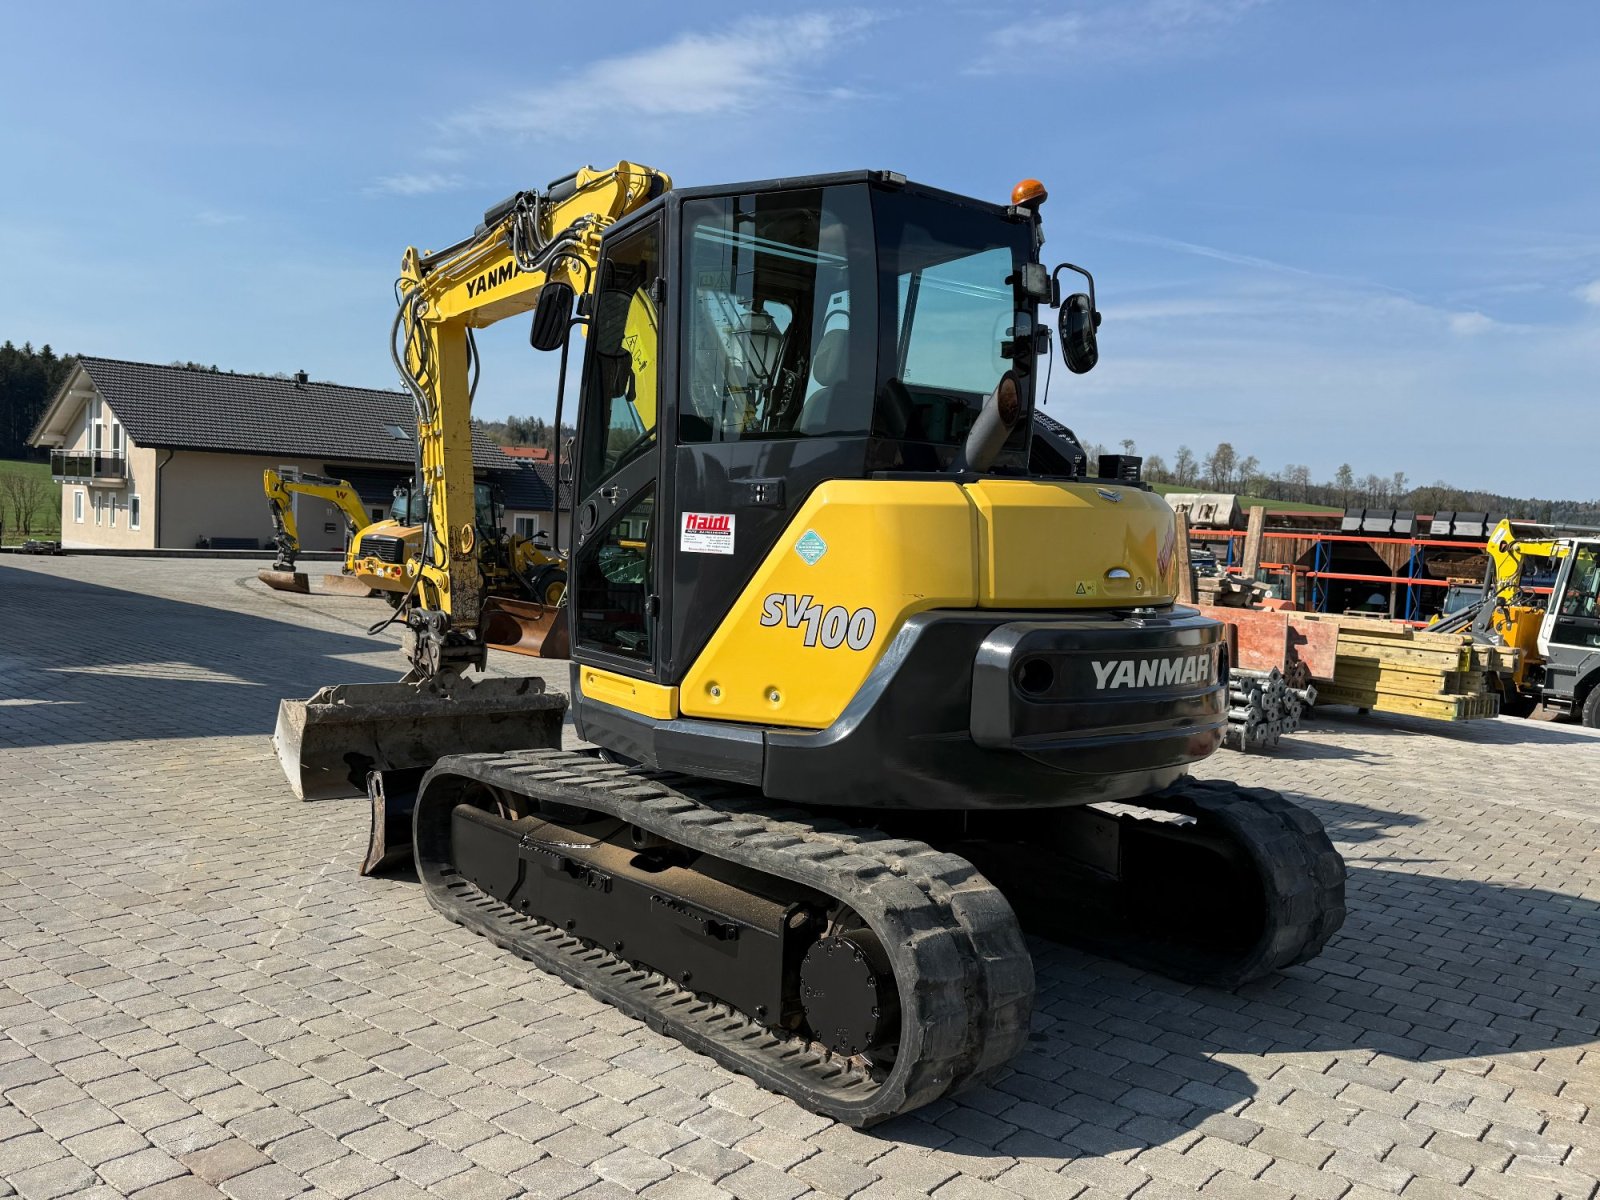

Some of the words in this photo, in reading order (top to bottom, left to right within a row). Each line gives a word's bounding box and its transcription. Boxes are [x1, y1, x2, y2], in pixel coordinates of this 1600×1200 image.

[466, 260, 528, 299] YANMA
[760, 593, 877, 651] SV100
[1091, 654, 1210, 690] YANMAR
